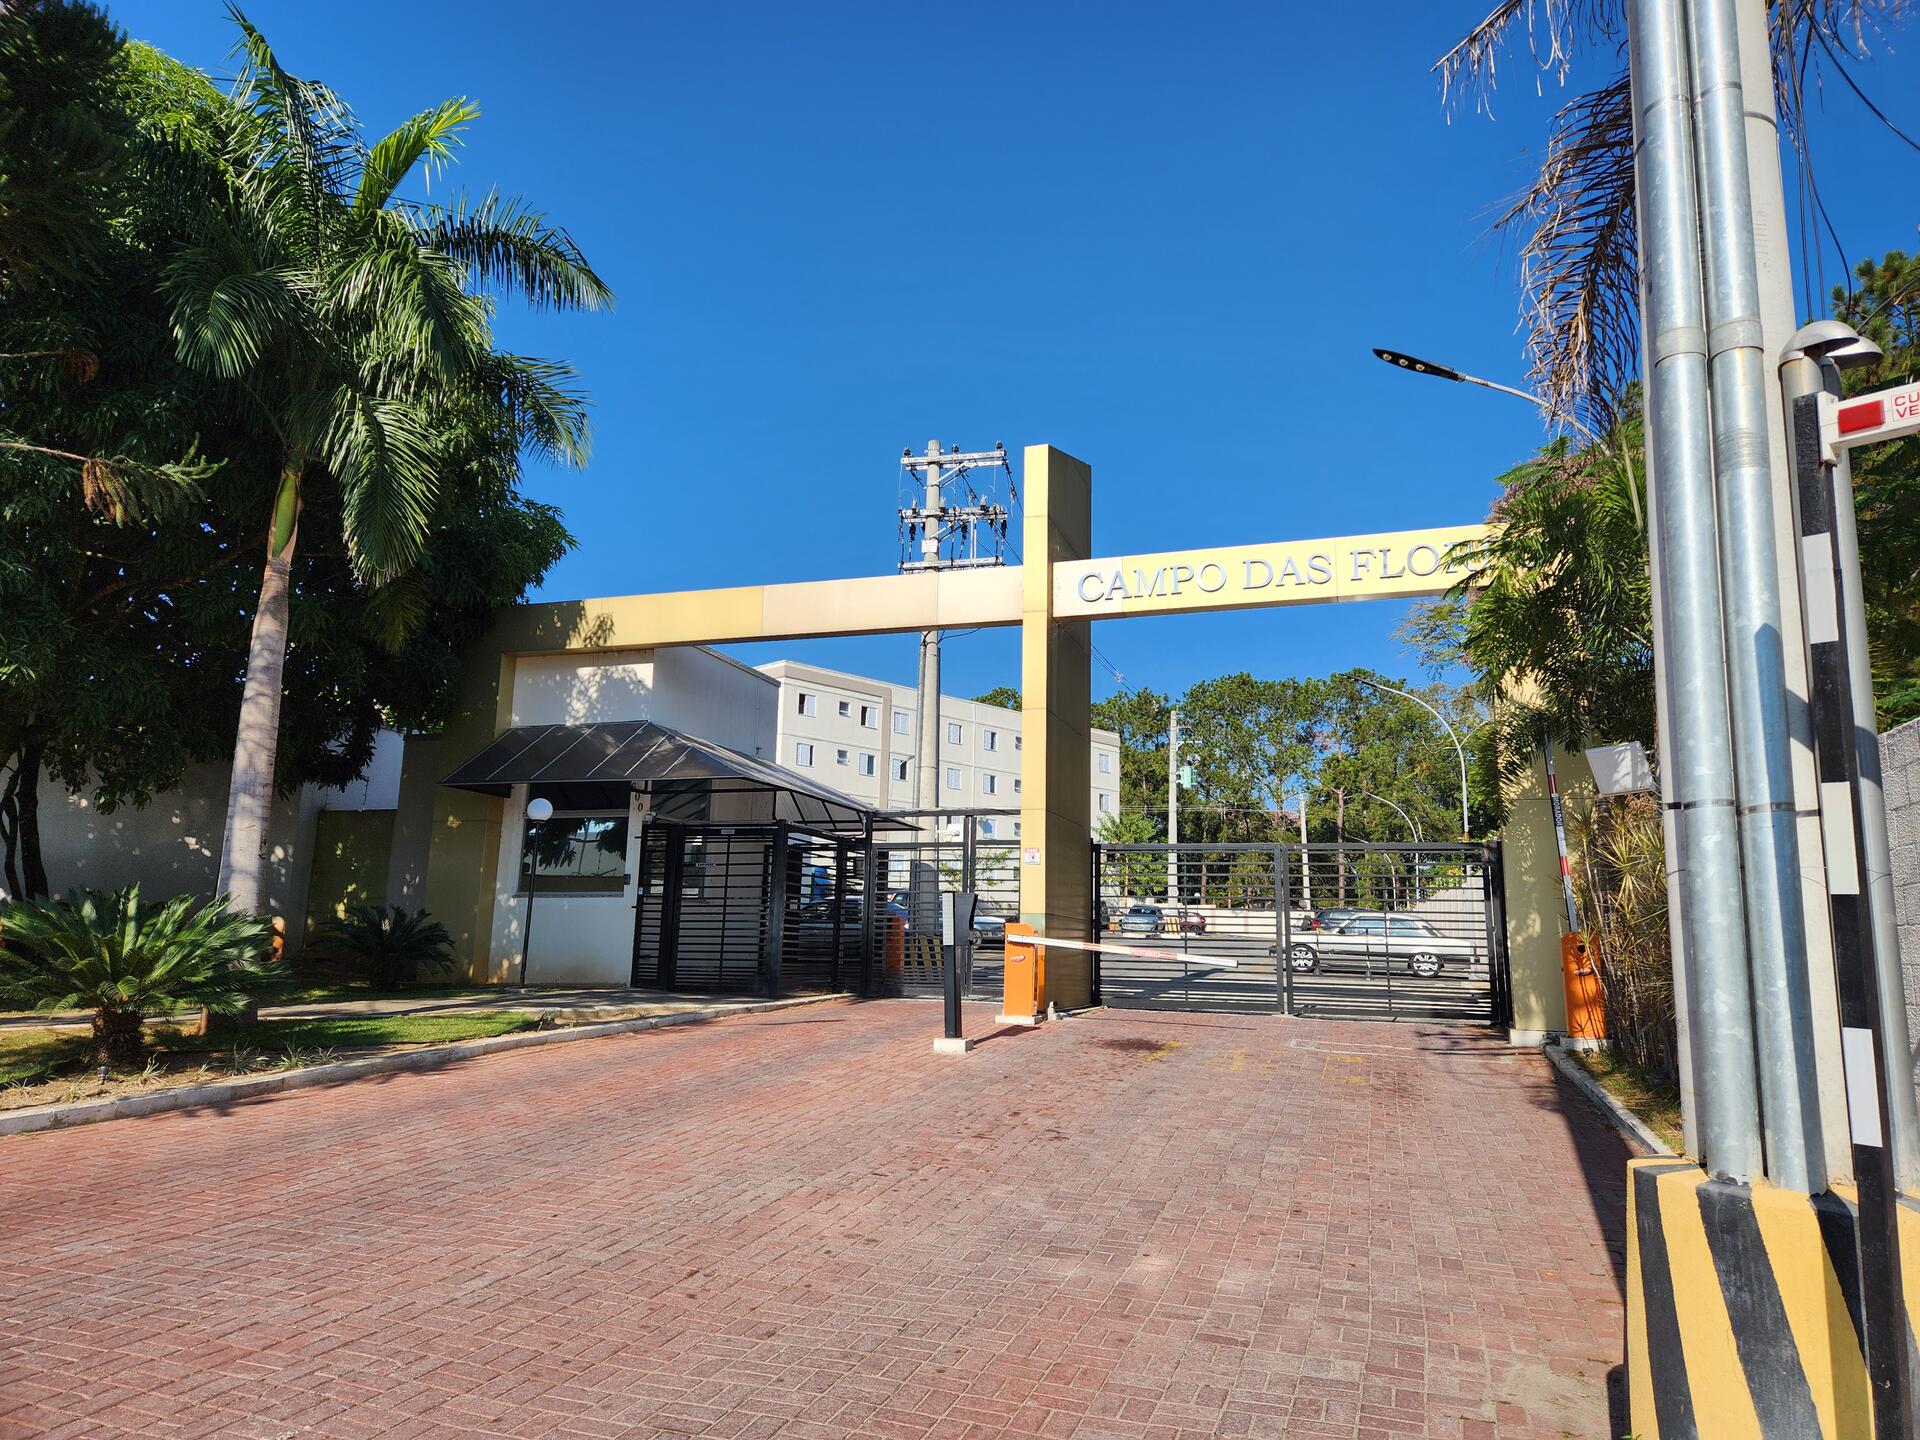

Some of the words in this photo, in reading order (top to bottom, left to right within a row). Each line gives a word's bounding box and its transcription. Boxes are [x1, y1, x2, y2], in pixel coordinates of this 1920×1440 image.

[1077, 563, 1228, 603] CAMPO
[1243, 552, 1333, 590] DAS
[1350, 538, 1503, 581] FLOR
